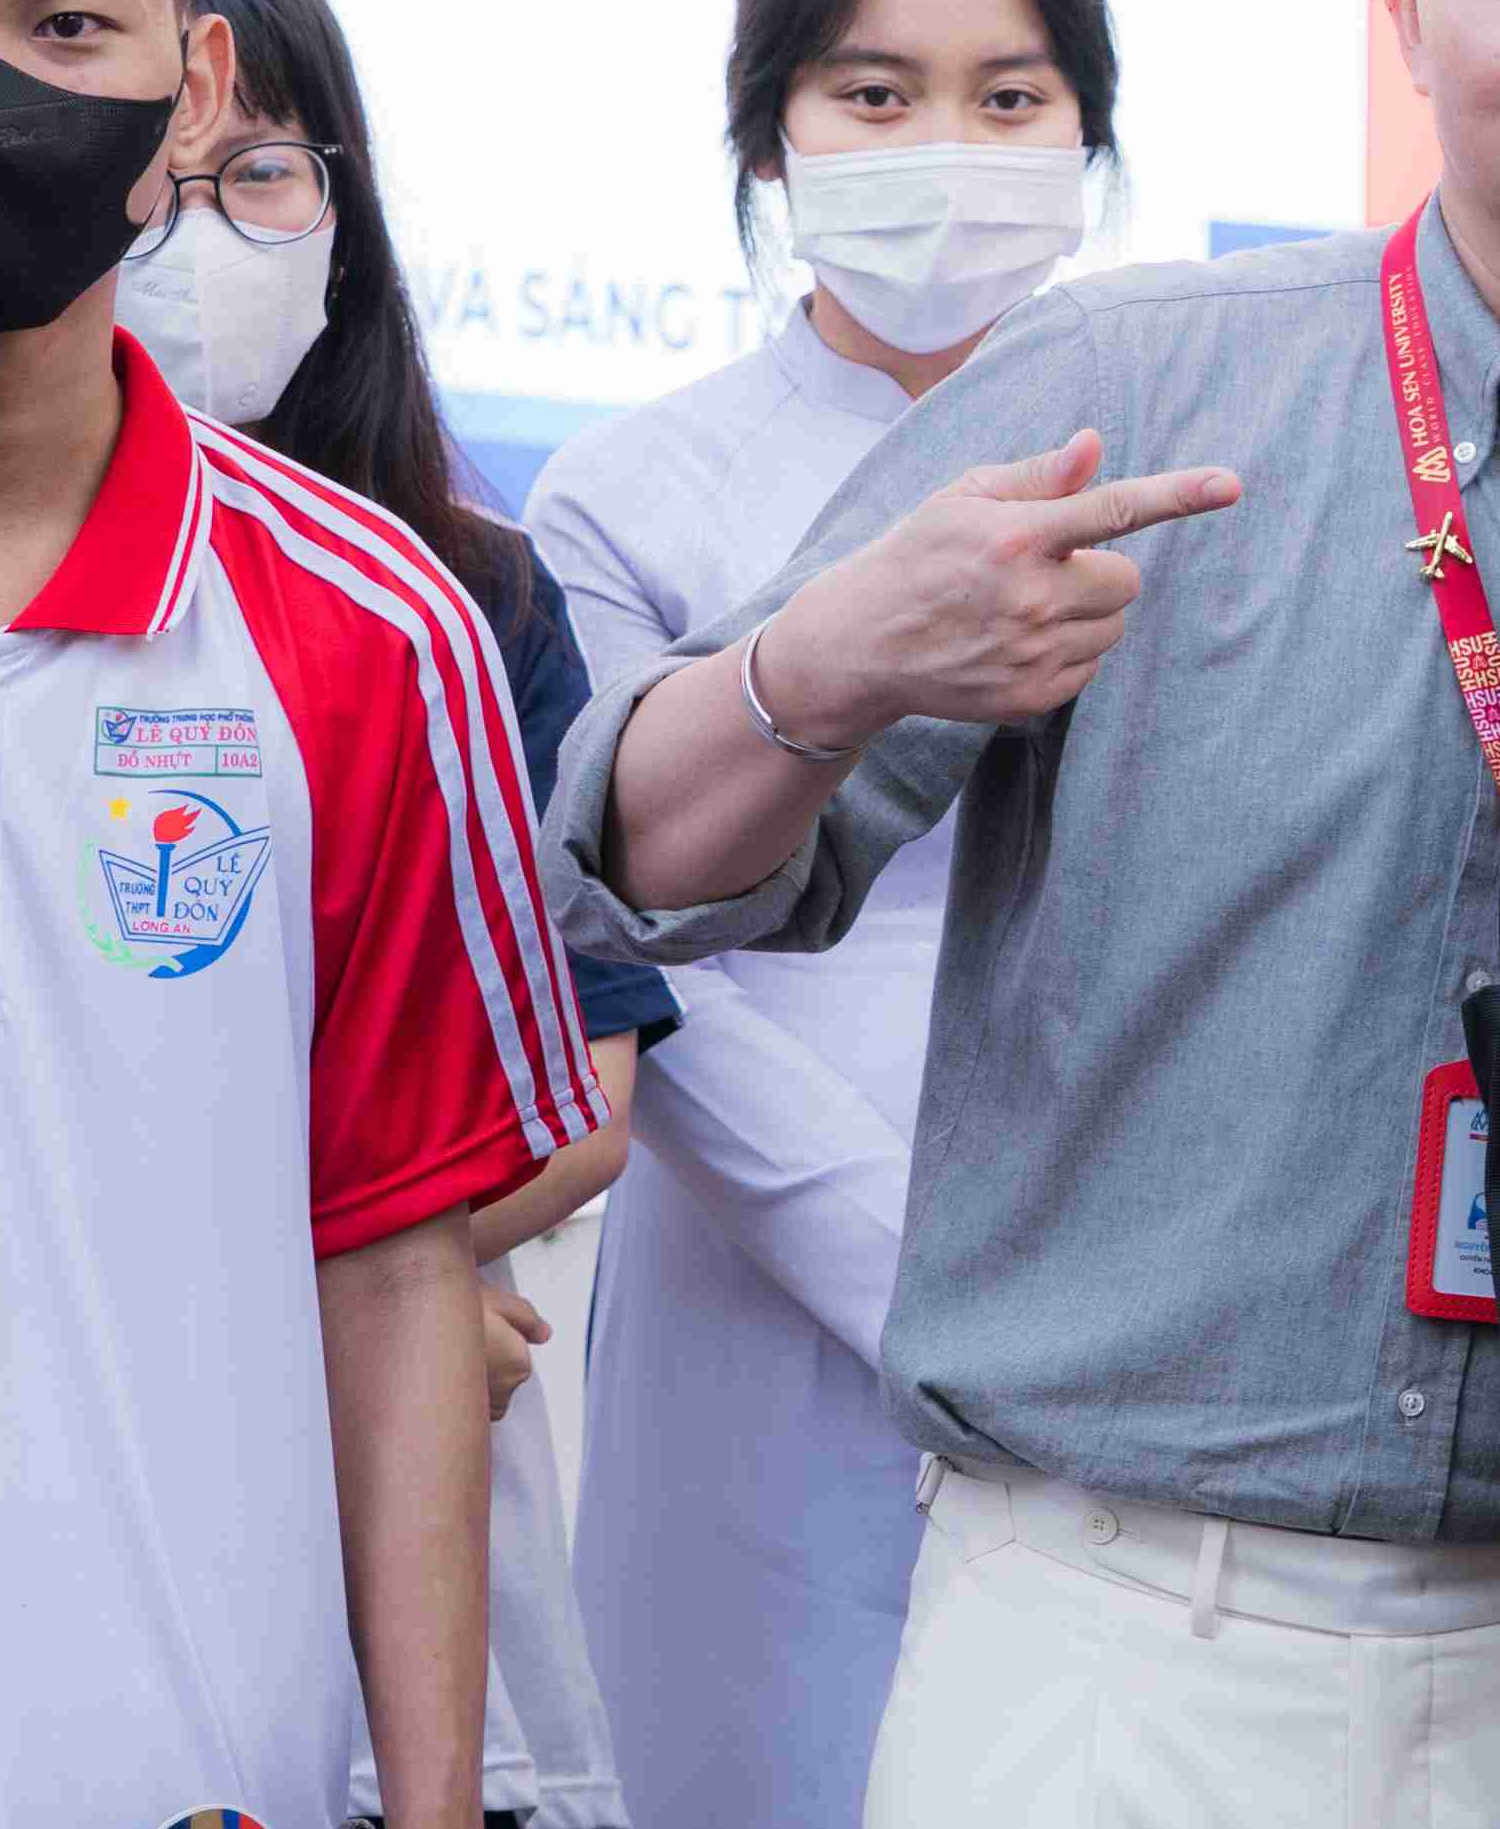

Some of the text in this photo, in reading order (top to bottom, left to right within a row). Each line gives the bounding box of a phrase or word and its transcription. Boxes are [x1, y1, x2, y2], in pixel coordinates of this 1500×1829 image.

[1388, 273, 1429, 449] HOA SEN UNIVERSITY
[1449, 635, 1484, 658] HSU
[135, 723, 163, 743] LÊ
[217, 722, 257, 742] ĐÔN
[216, 852, 243, 873] LÊ
[132, 921, 191, 935] LONG AN
